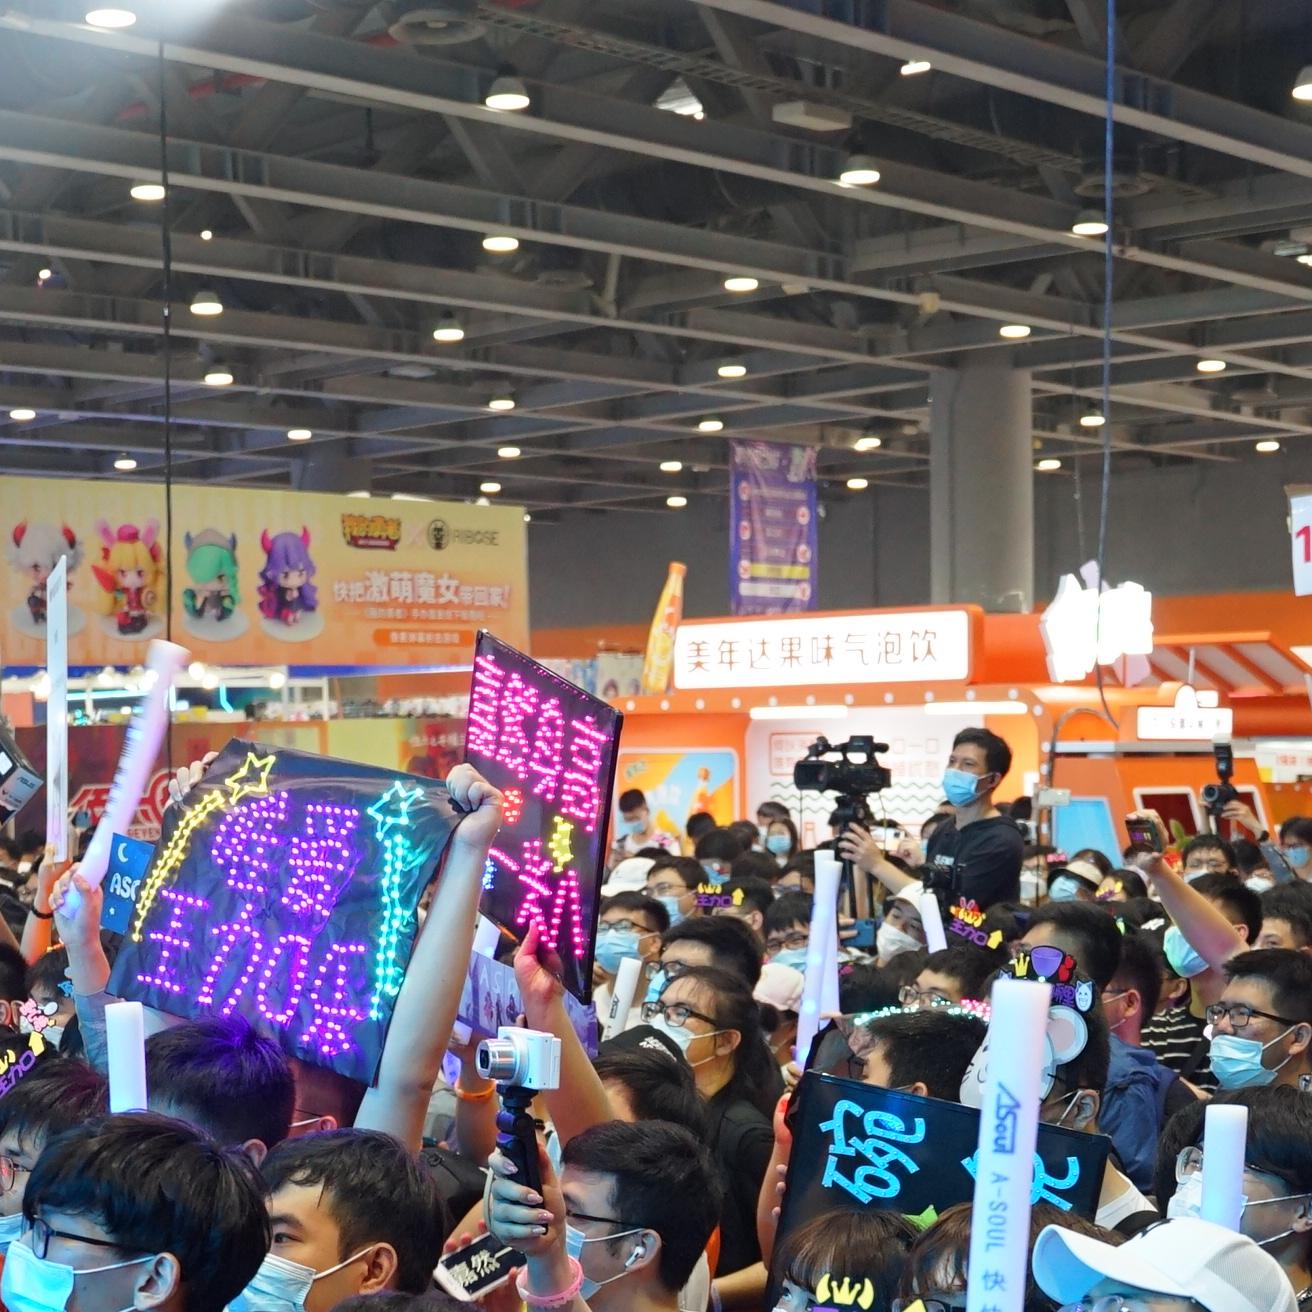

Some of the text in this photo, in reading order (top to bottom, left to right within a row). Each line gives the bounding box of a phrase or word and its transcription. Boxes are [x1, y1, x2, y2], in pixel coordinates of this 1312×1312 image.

[687, 629, 937, 672] 美年达果味气泡饮
[985, 1172, 1013, 1254] A-SOUL
